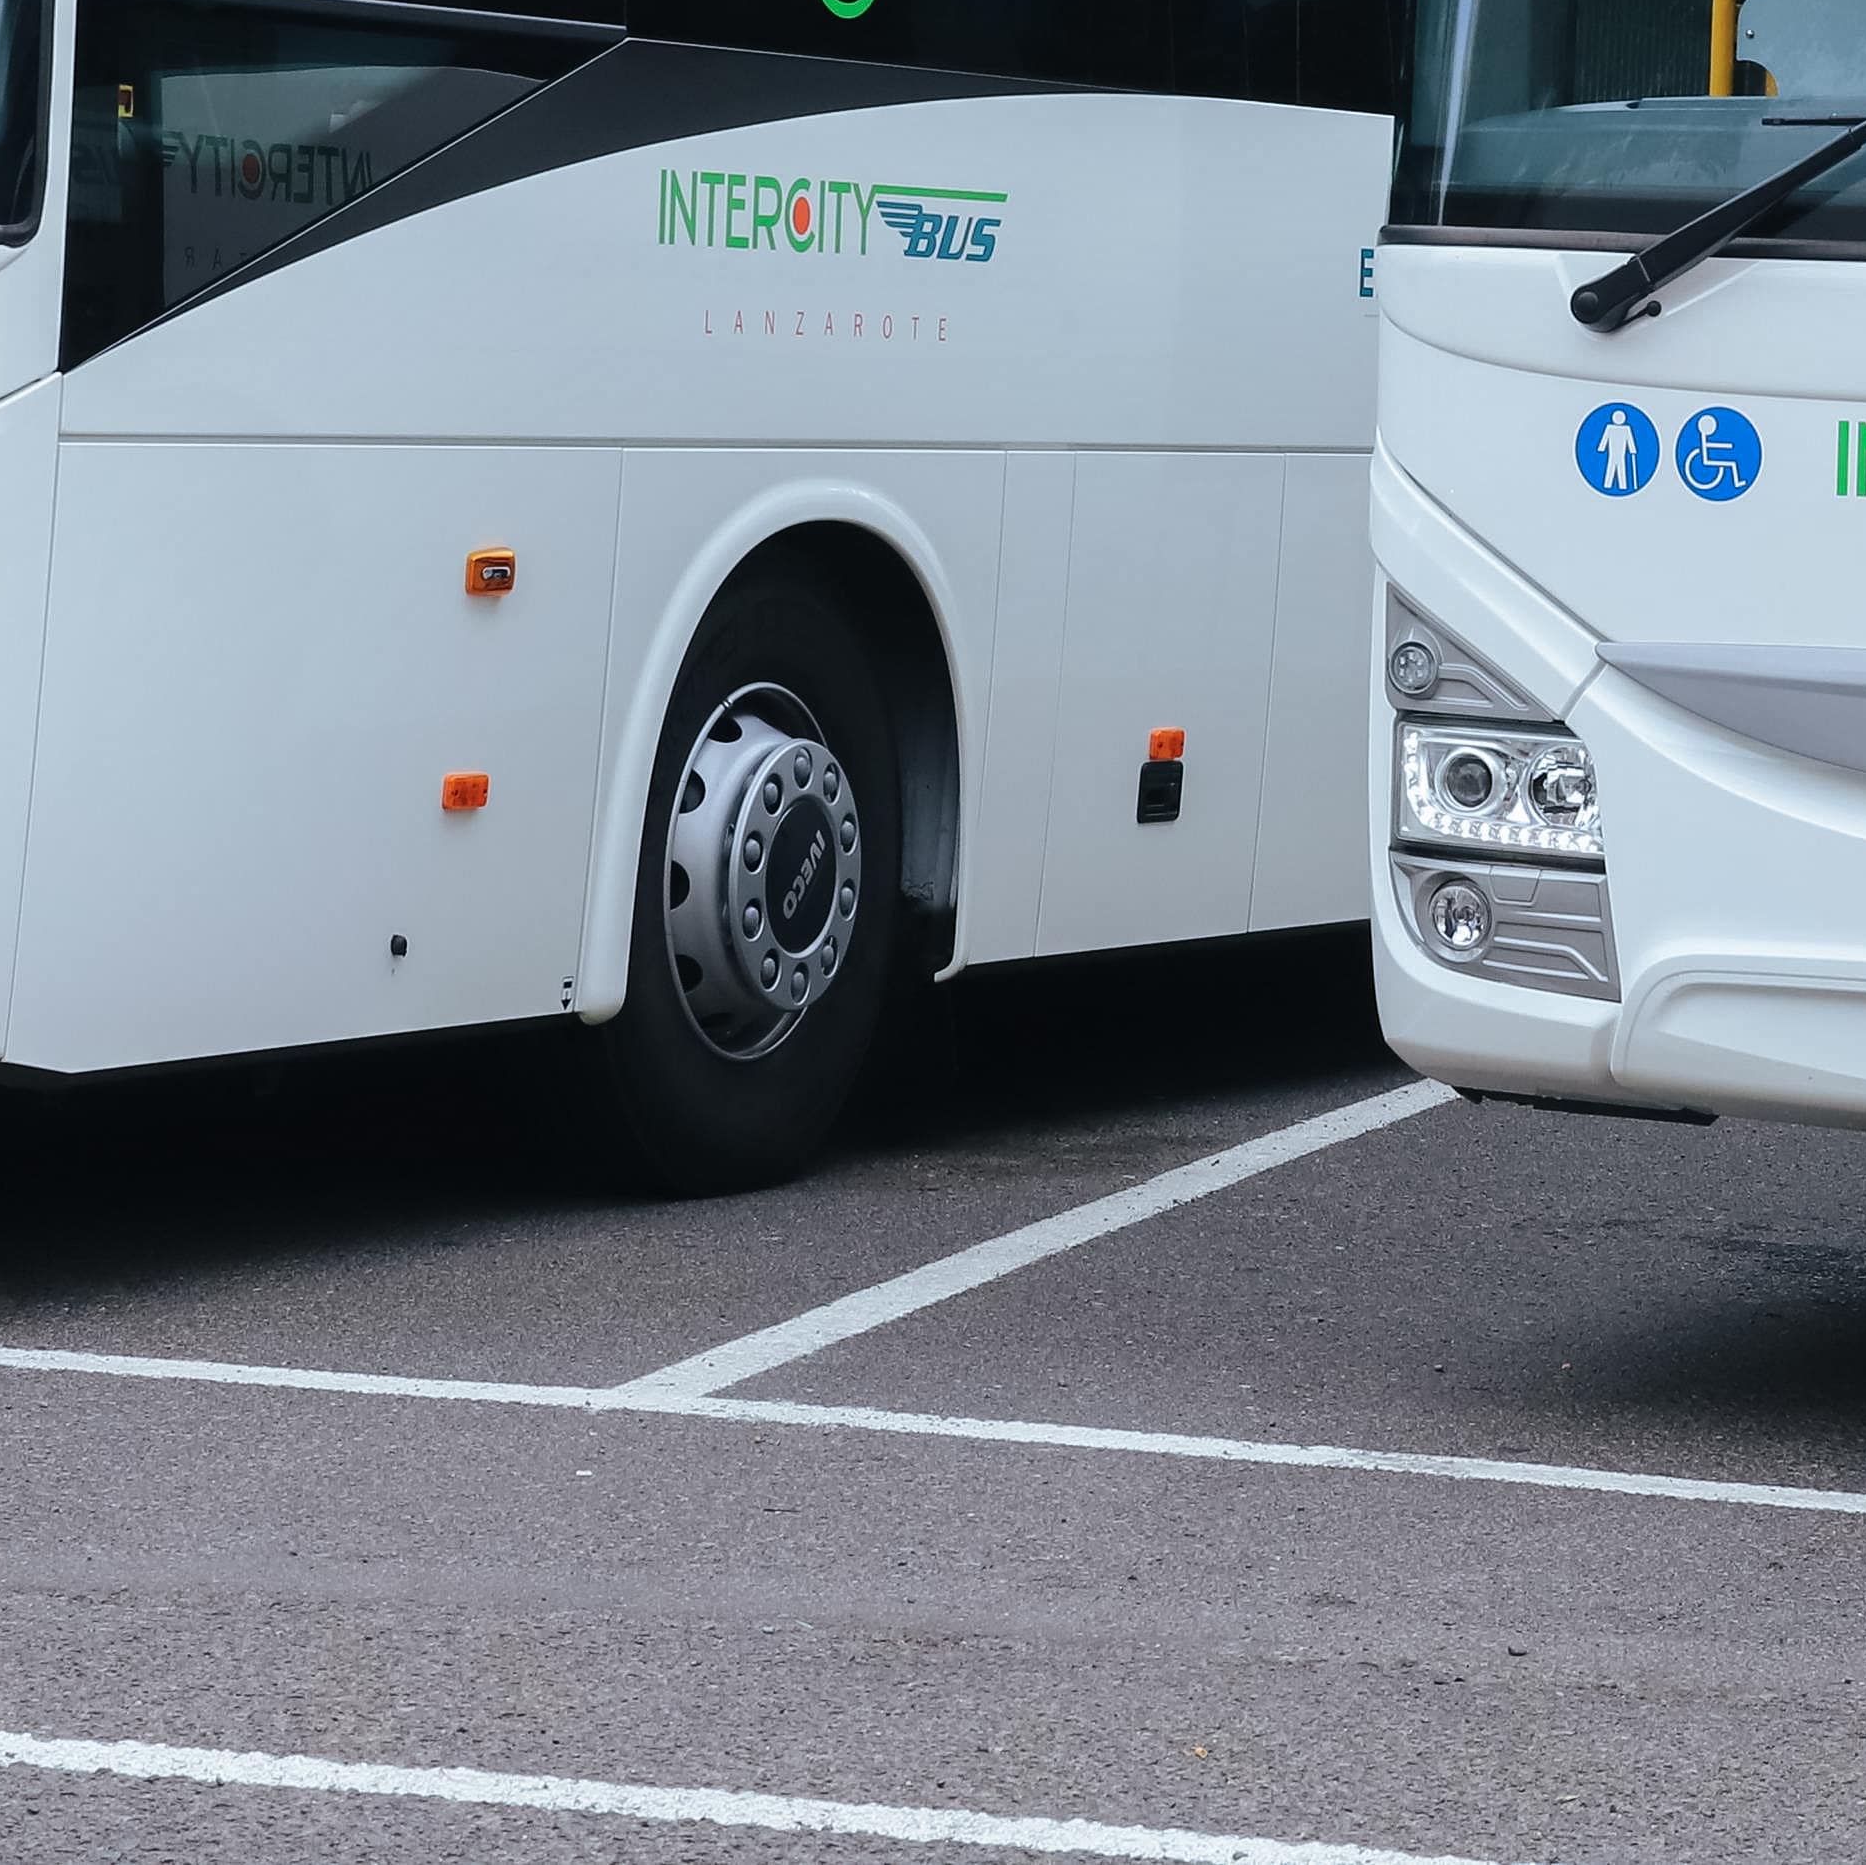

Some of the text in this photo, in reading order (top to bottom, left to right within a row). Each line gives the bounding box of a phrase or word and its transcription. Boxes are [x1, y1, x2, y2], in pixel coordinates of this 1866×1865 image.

[658, 168, 1001, 262] INTERCITY BUS
[704, 309, 948, 342] LANZAROTE
[783, 829, 826, 920] IVECO
